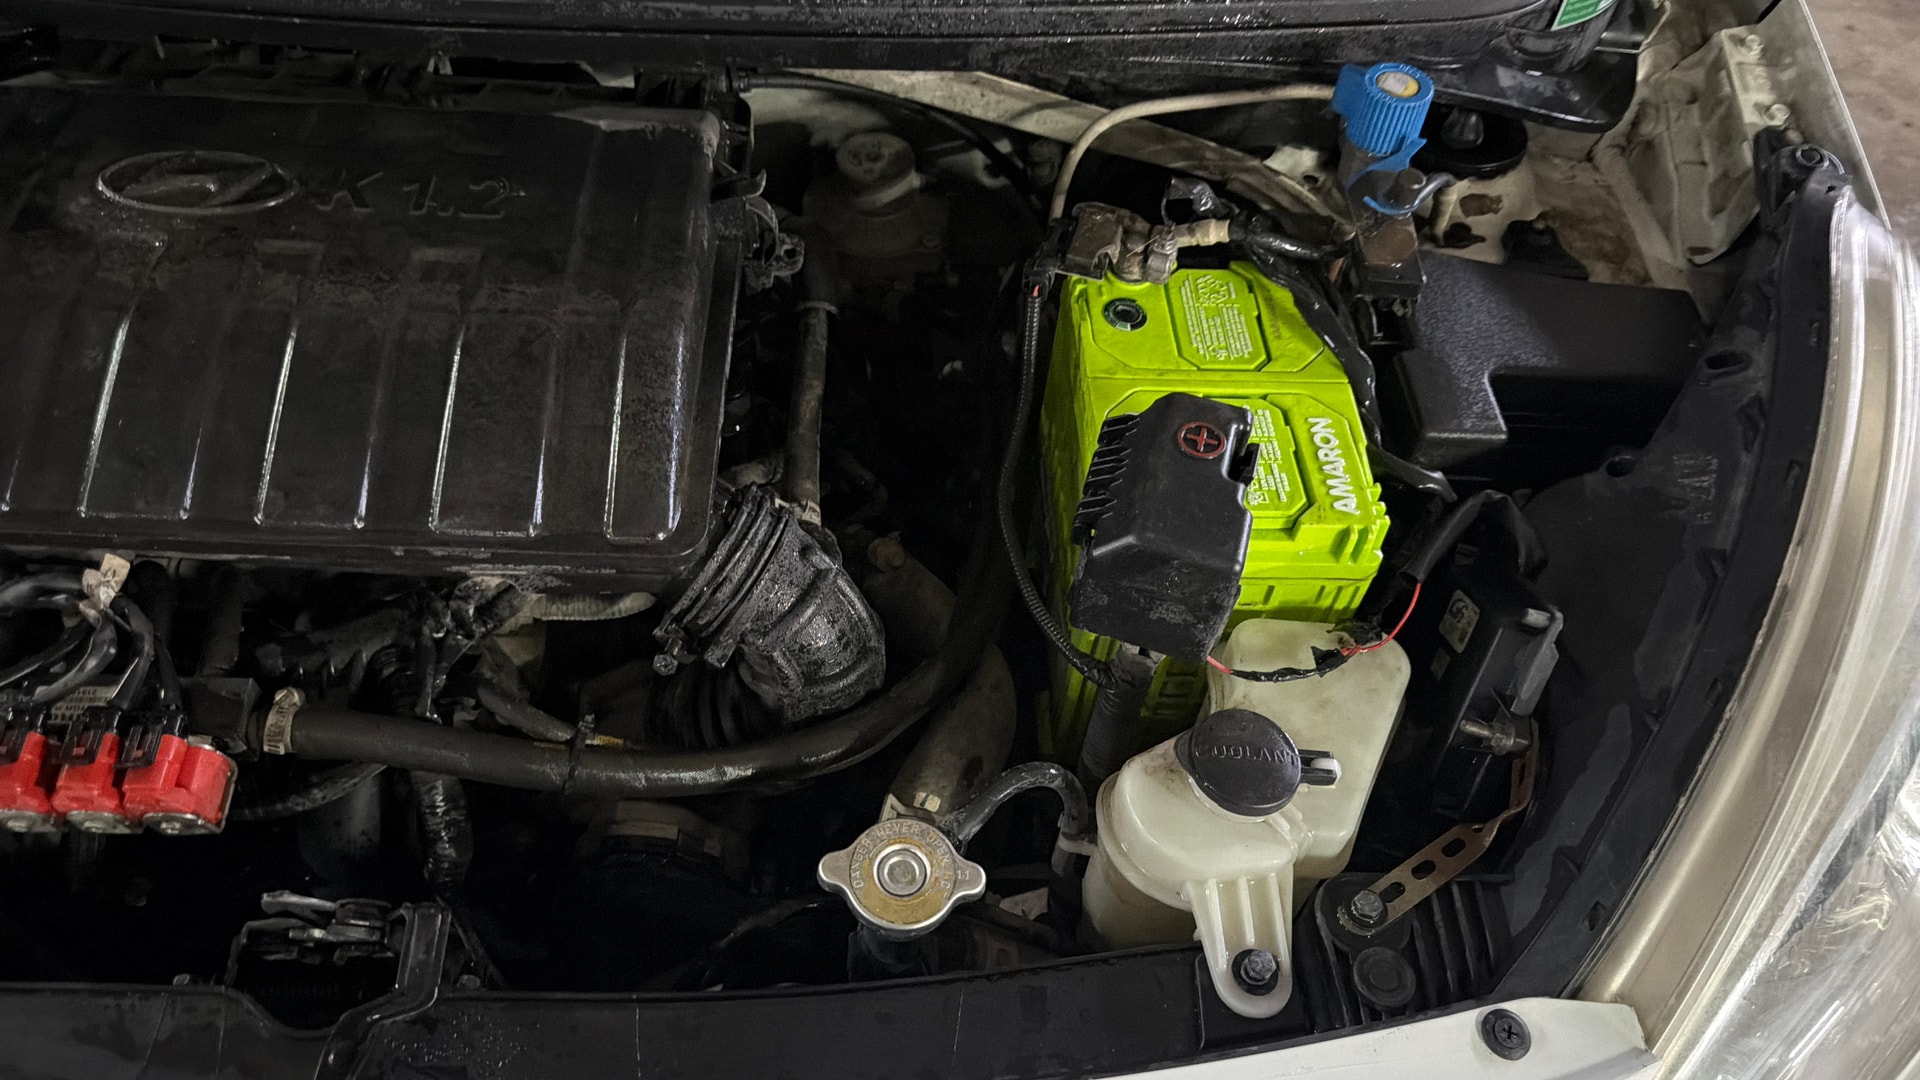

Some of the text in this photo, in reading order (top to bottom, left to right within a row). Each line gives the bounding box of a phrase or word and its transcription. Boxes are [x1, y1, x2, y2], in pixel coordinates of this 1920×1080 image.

[1308, 417, 1361, 515] AMARON
[1195, 744, 1298, 766] OOLANT
[850, 837, 872, 890] DANGER
